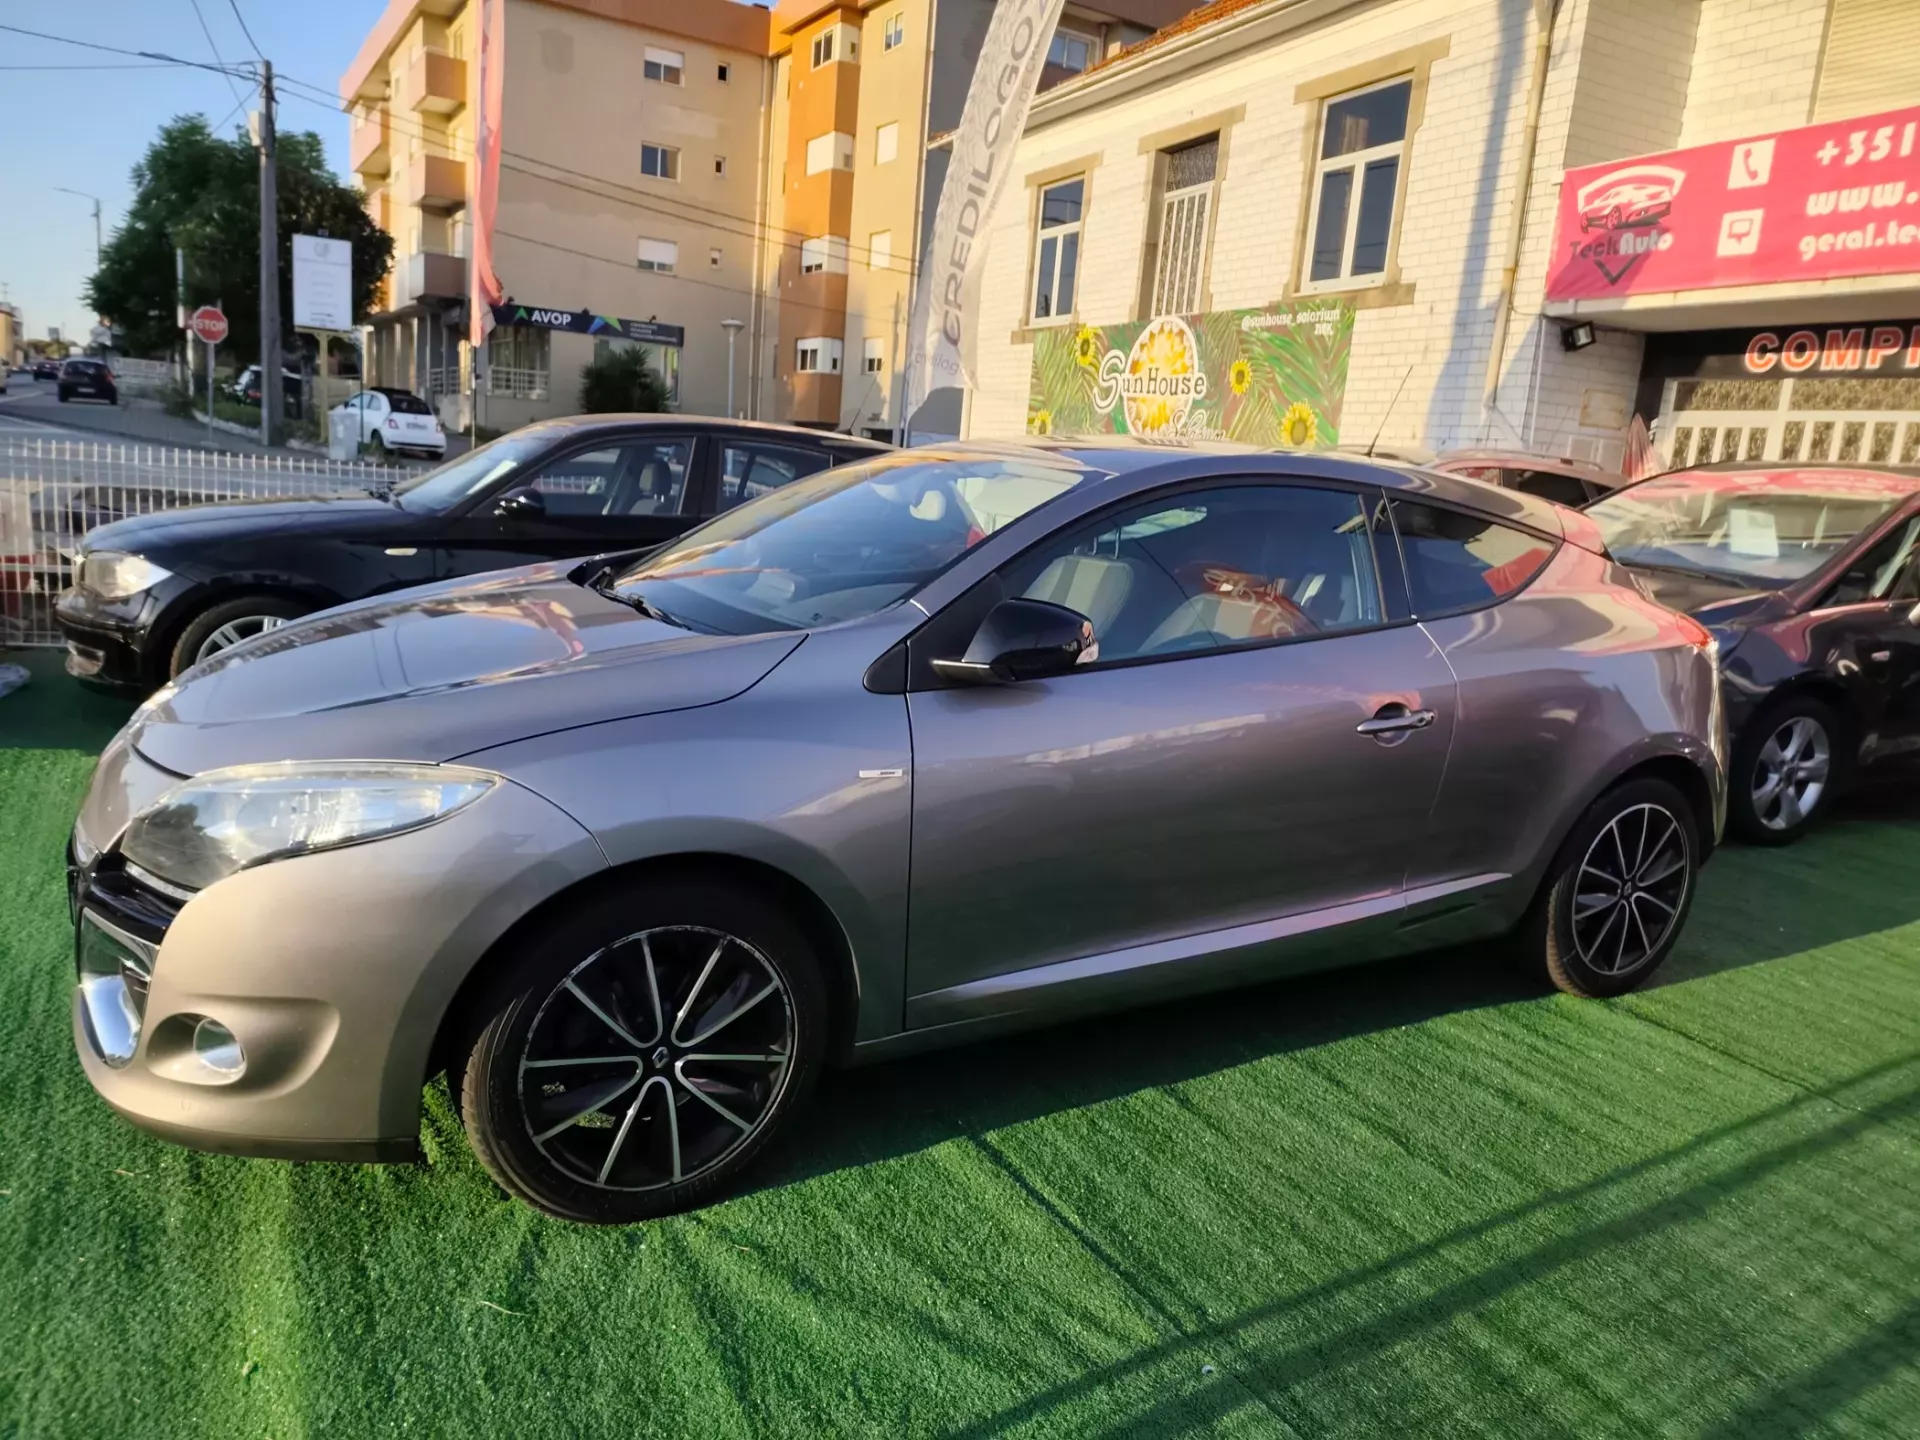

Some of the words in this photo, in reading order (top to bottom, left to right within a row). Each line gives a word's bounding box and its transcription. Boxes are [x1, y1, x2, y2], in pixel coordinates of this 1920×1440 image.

[1815, 121, 1916, 166] +351
[943, 16, 1033, 347] CREDILOGO
[1805, 180, 1919, 216] www.
[1798, 220, 1920, 262] geral.te
[196, 319, 226, 332] STOP
[531, 309, 572, 326] AVOP
